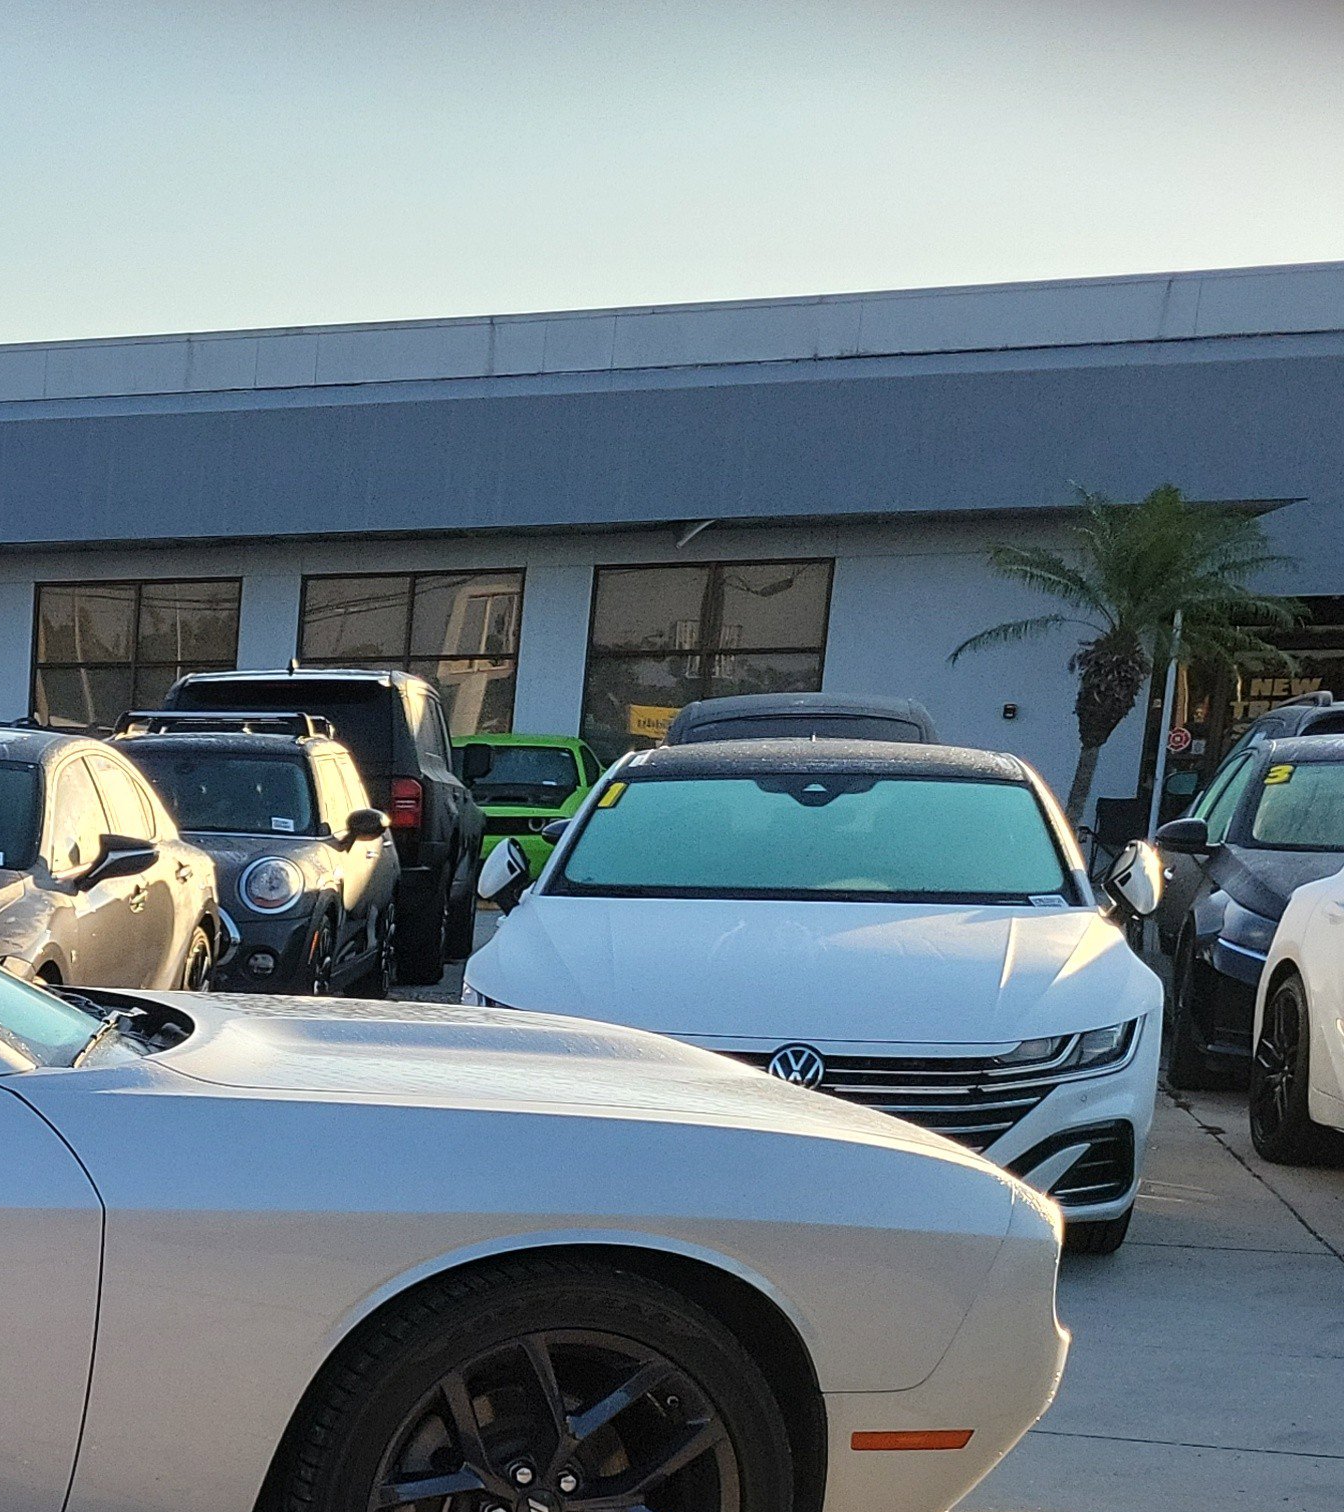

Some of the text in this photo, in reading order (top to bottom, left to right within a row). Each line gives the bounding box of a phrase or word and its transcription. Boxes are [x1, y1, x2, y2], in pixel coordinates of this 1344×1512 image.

[1250, 678, 1323, 696] NEW
[1263, 764, 1295, 785] 3
[597, 782, 628, 808] 1
[772, 1048, 822, 1086] VW
